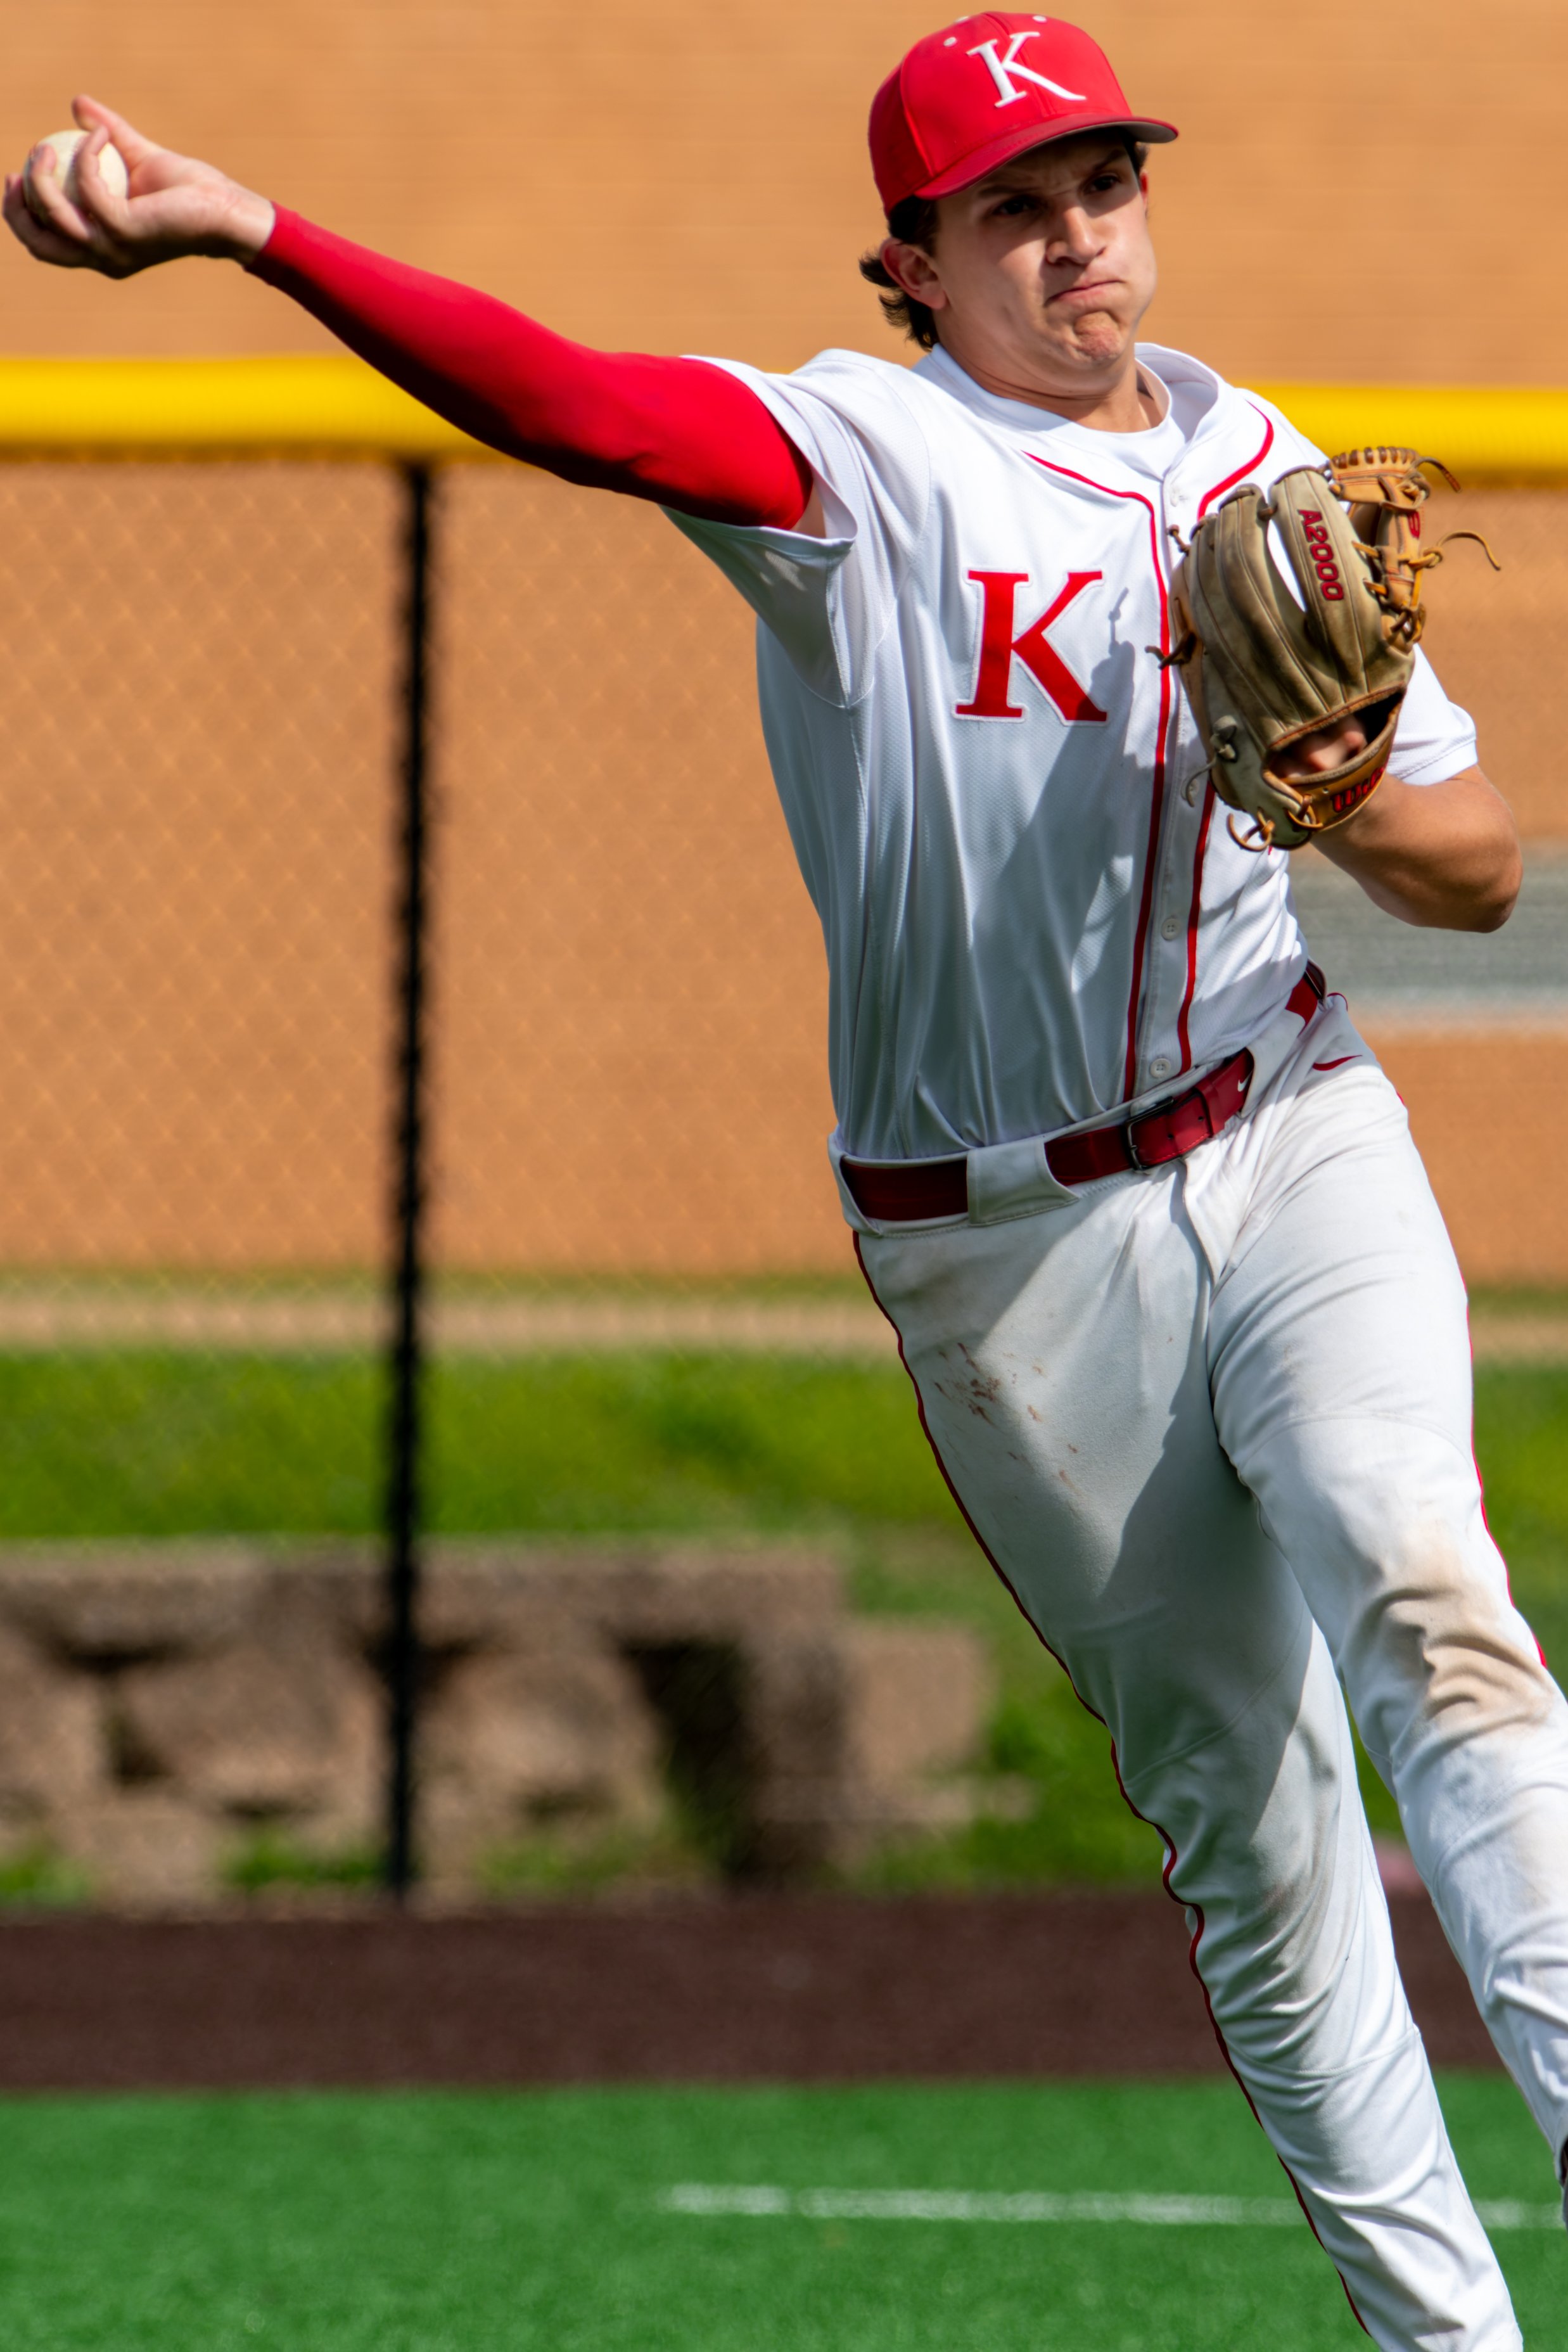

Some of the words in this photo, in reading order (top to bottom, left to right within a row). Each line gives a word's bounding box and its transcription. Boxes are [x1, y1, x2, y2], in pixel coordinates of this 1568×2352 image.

[966, 31, 1087, 108] K
[1297, 509, 1344, 601] A2000
[953, 569, 1109, 724] K
